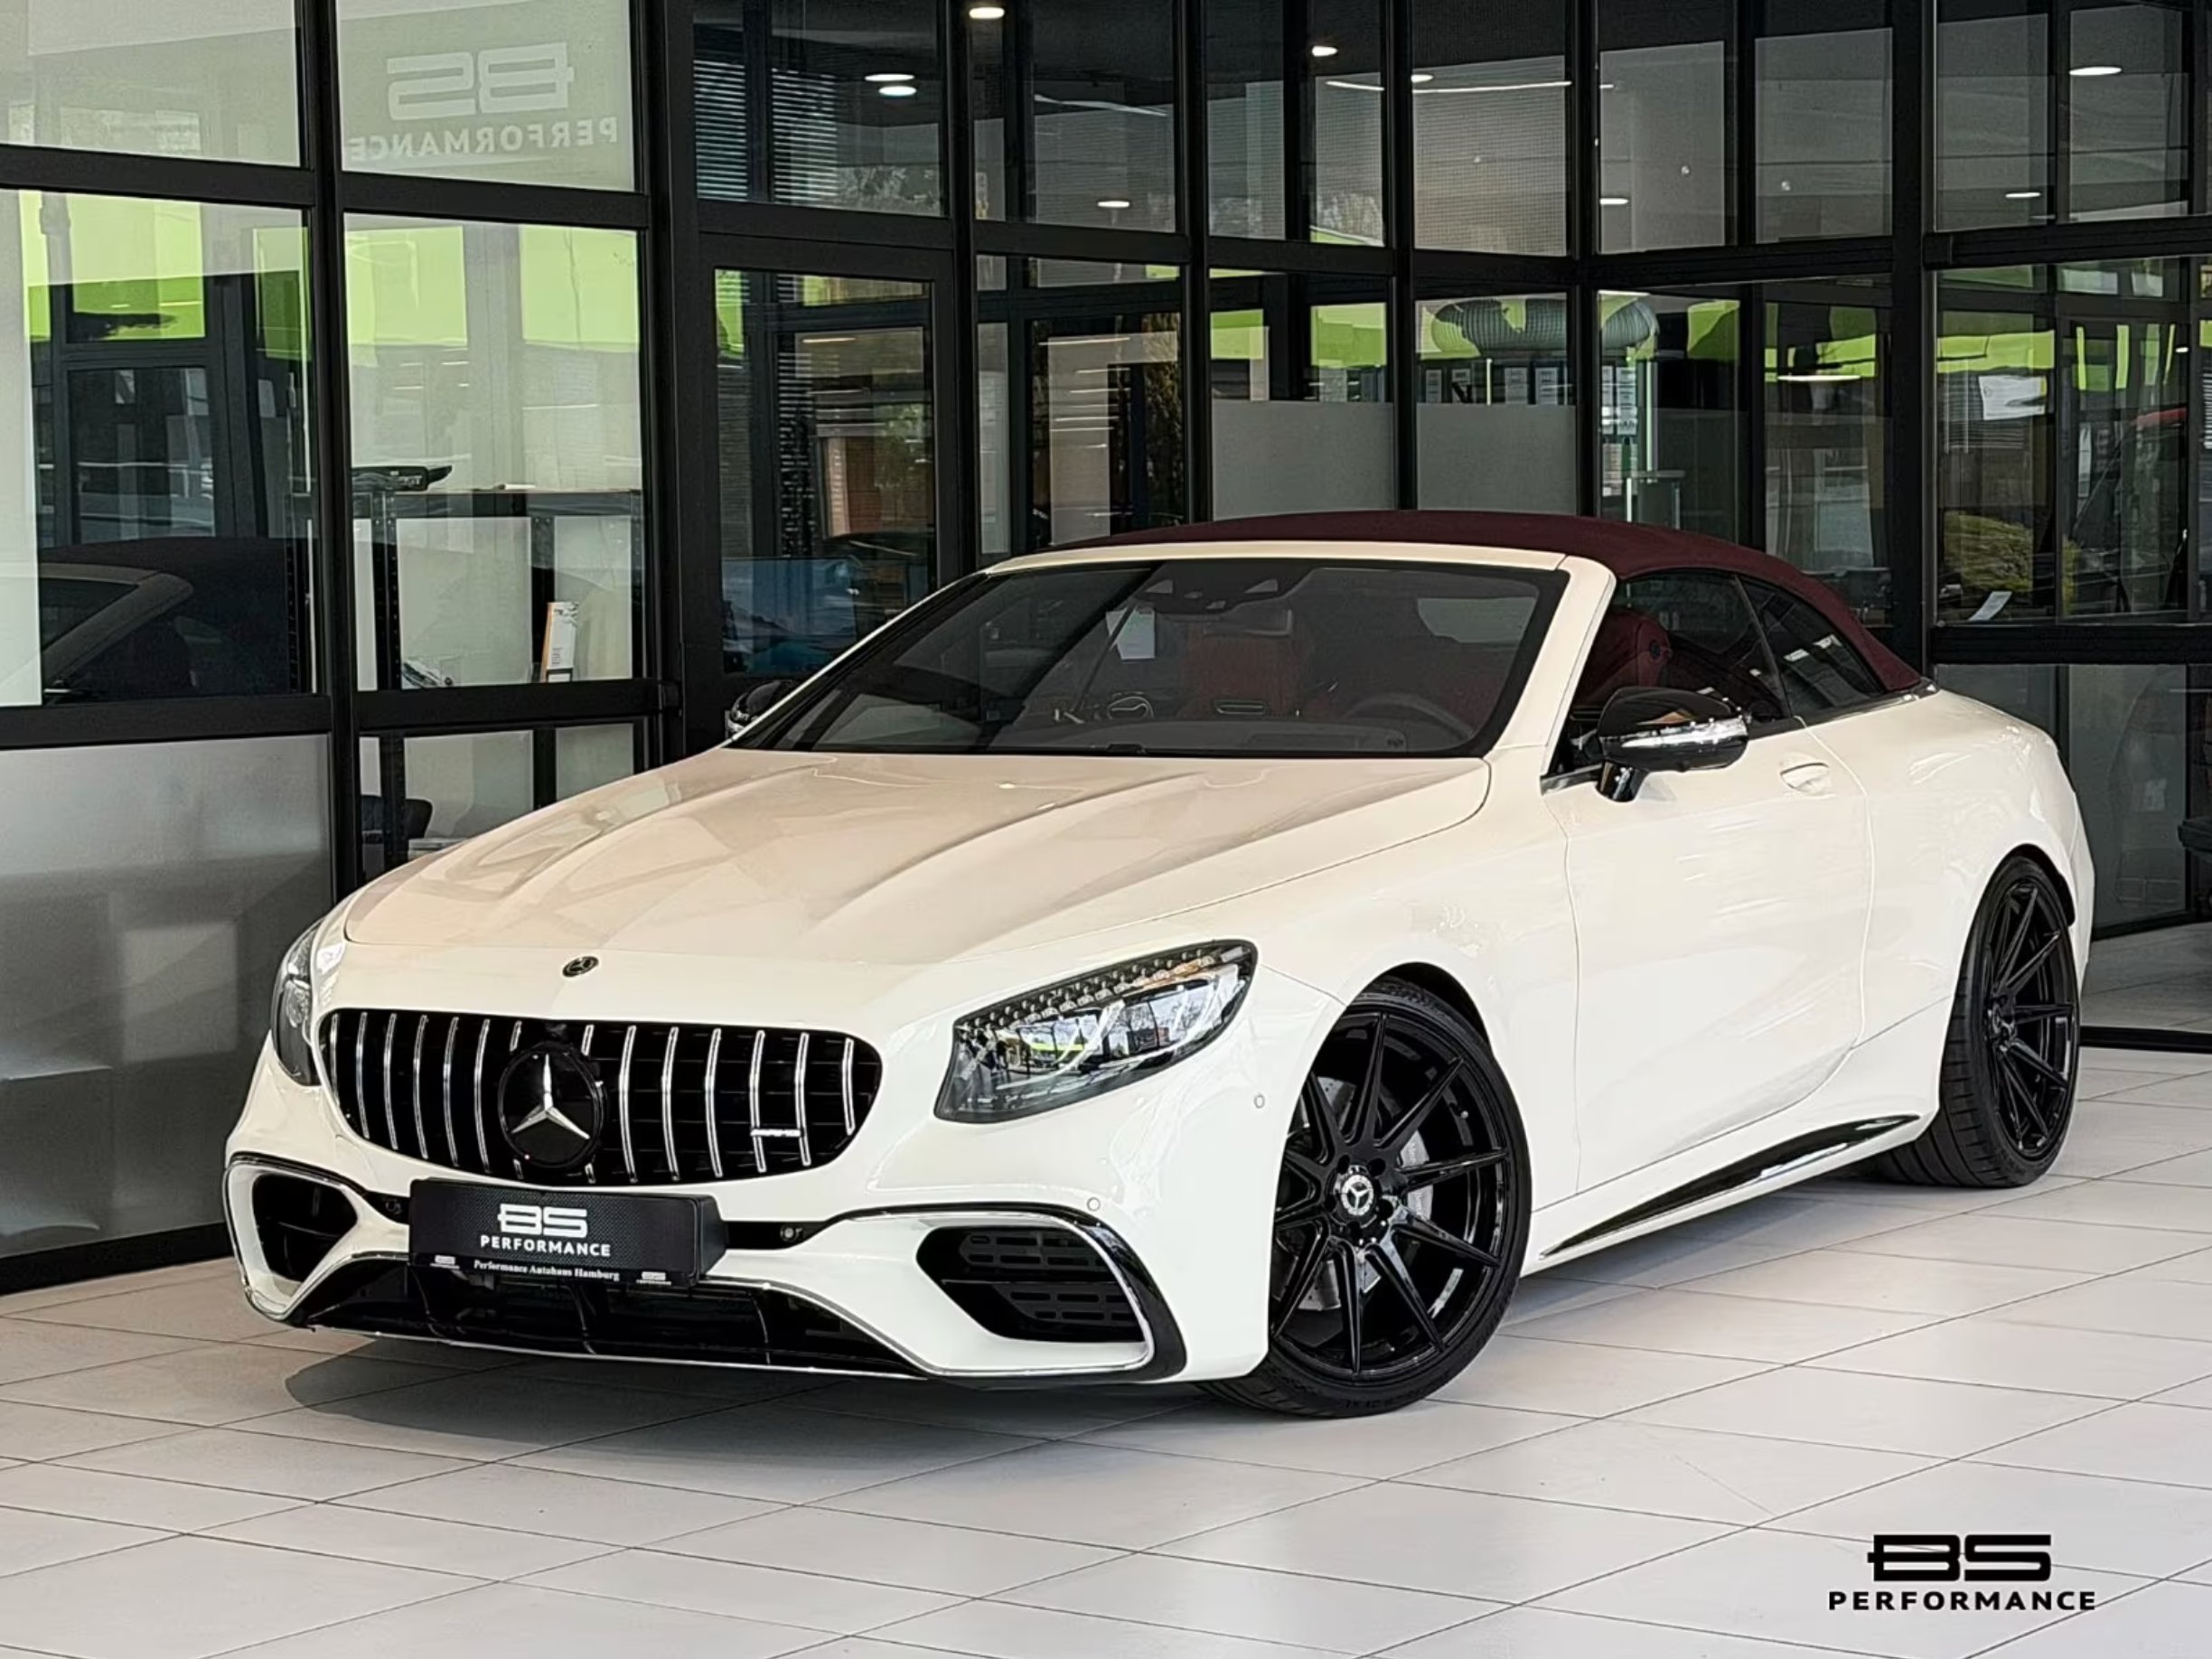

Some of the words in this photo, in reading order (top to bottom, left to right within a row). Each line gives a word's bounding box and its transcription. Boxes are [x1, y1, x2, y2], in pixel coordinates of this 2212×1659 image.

[497, 1203, 588, 1239] BS
[480, 1234, 612, 1257] PERFORMANCE
[473, 1259, 528, 1274] Performance
[530, 1264, 573, 1277] Autohaus
[574, 1267, 621, 1282] Hamburg
